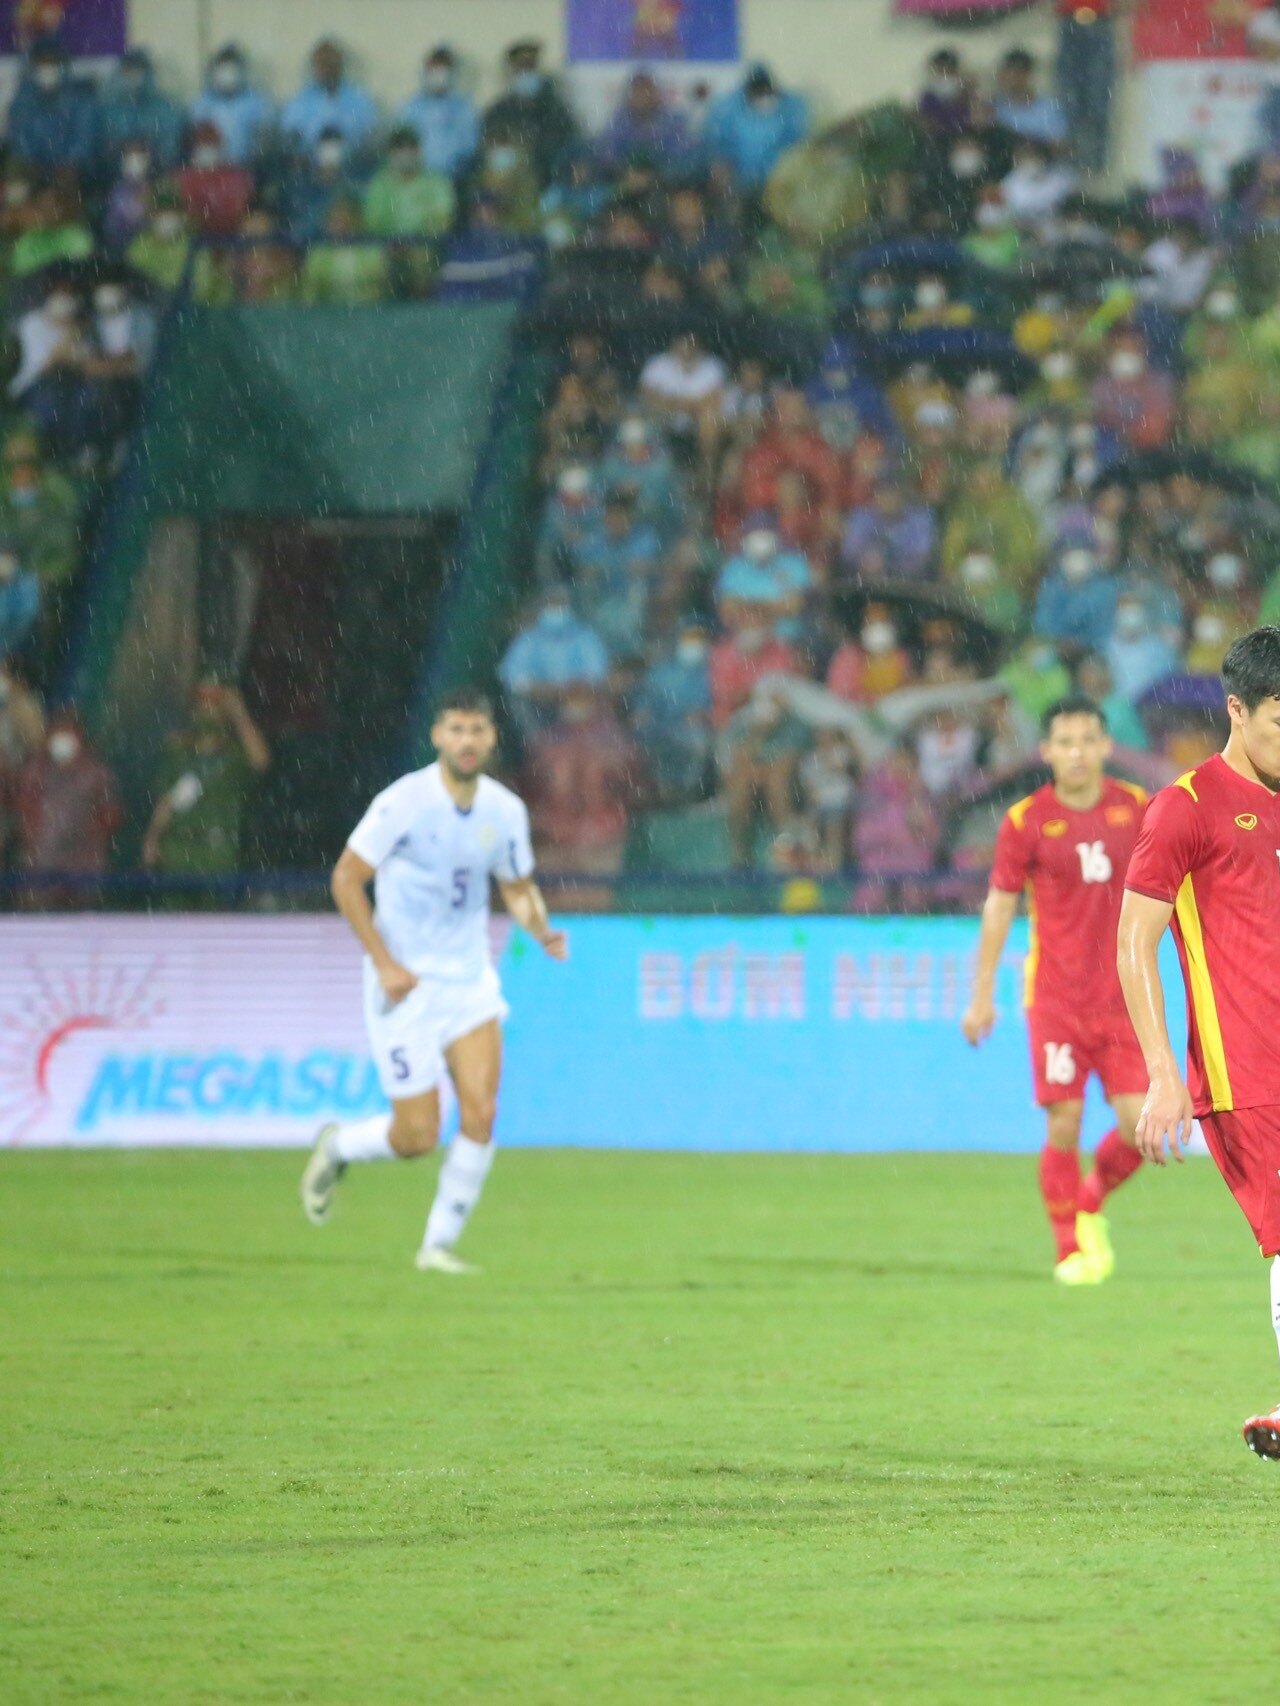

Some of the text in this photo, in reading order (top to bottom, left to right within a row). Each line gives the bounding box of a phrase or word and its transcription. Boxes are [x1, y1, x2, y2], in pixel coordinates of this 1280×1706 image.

[1075, 840, 1112, 883] 16
[452, 866, 469, 910] 5
[390, 1047, 410, 1080] 5
[1043, 1041, 1076, 1085] 16
[76, 1051, 393, 1130] MEGASU
